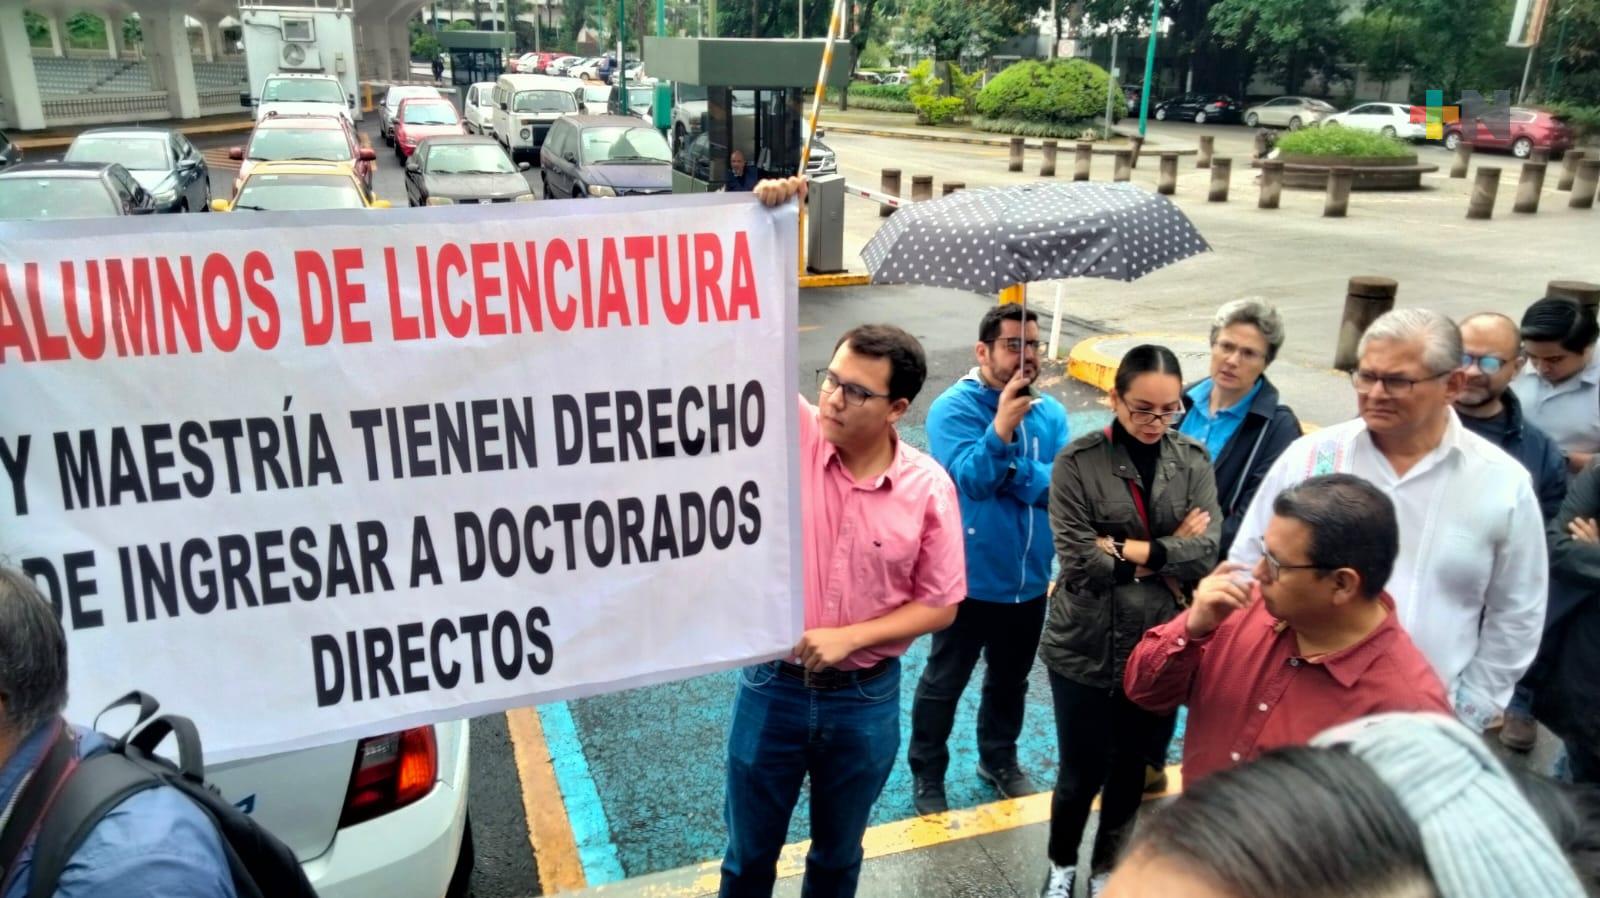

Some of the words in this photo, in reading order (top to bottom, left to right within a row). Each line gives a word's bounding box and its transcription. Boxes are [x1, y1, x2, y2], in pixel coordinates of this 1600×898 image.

[0, 250, 281, 363] ALUMNOS
[294, 248, 373, 346] DE
[384, 231, 760, 341] LICENCIATURA
[0, 434, 31, 516] Y
[53, 395, 344, 511] MAESTRÍA
[350, 396, 538, 482] TIENEN
[552, 380, 766, 467] DERECHO
[21, 550, 104, 630] DE
[118, 520, 395, 623] INGRESAR
[409, 515, 442, 588] A
[454, 480, 762, 583] DOCTORADOS
[311, 606, 554, 707] DIRECTOS
